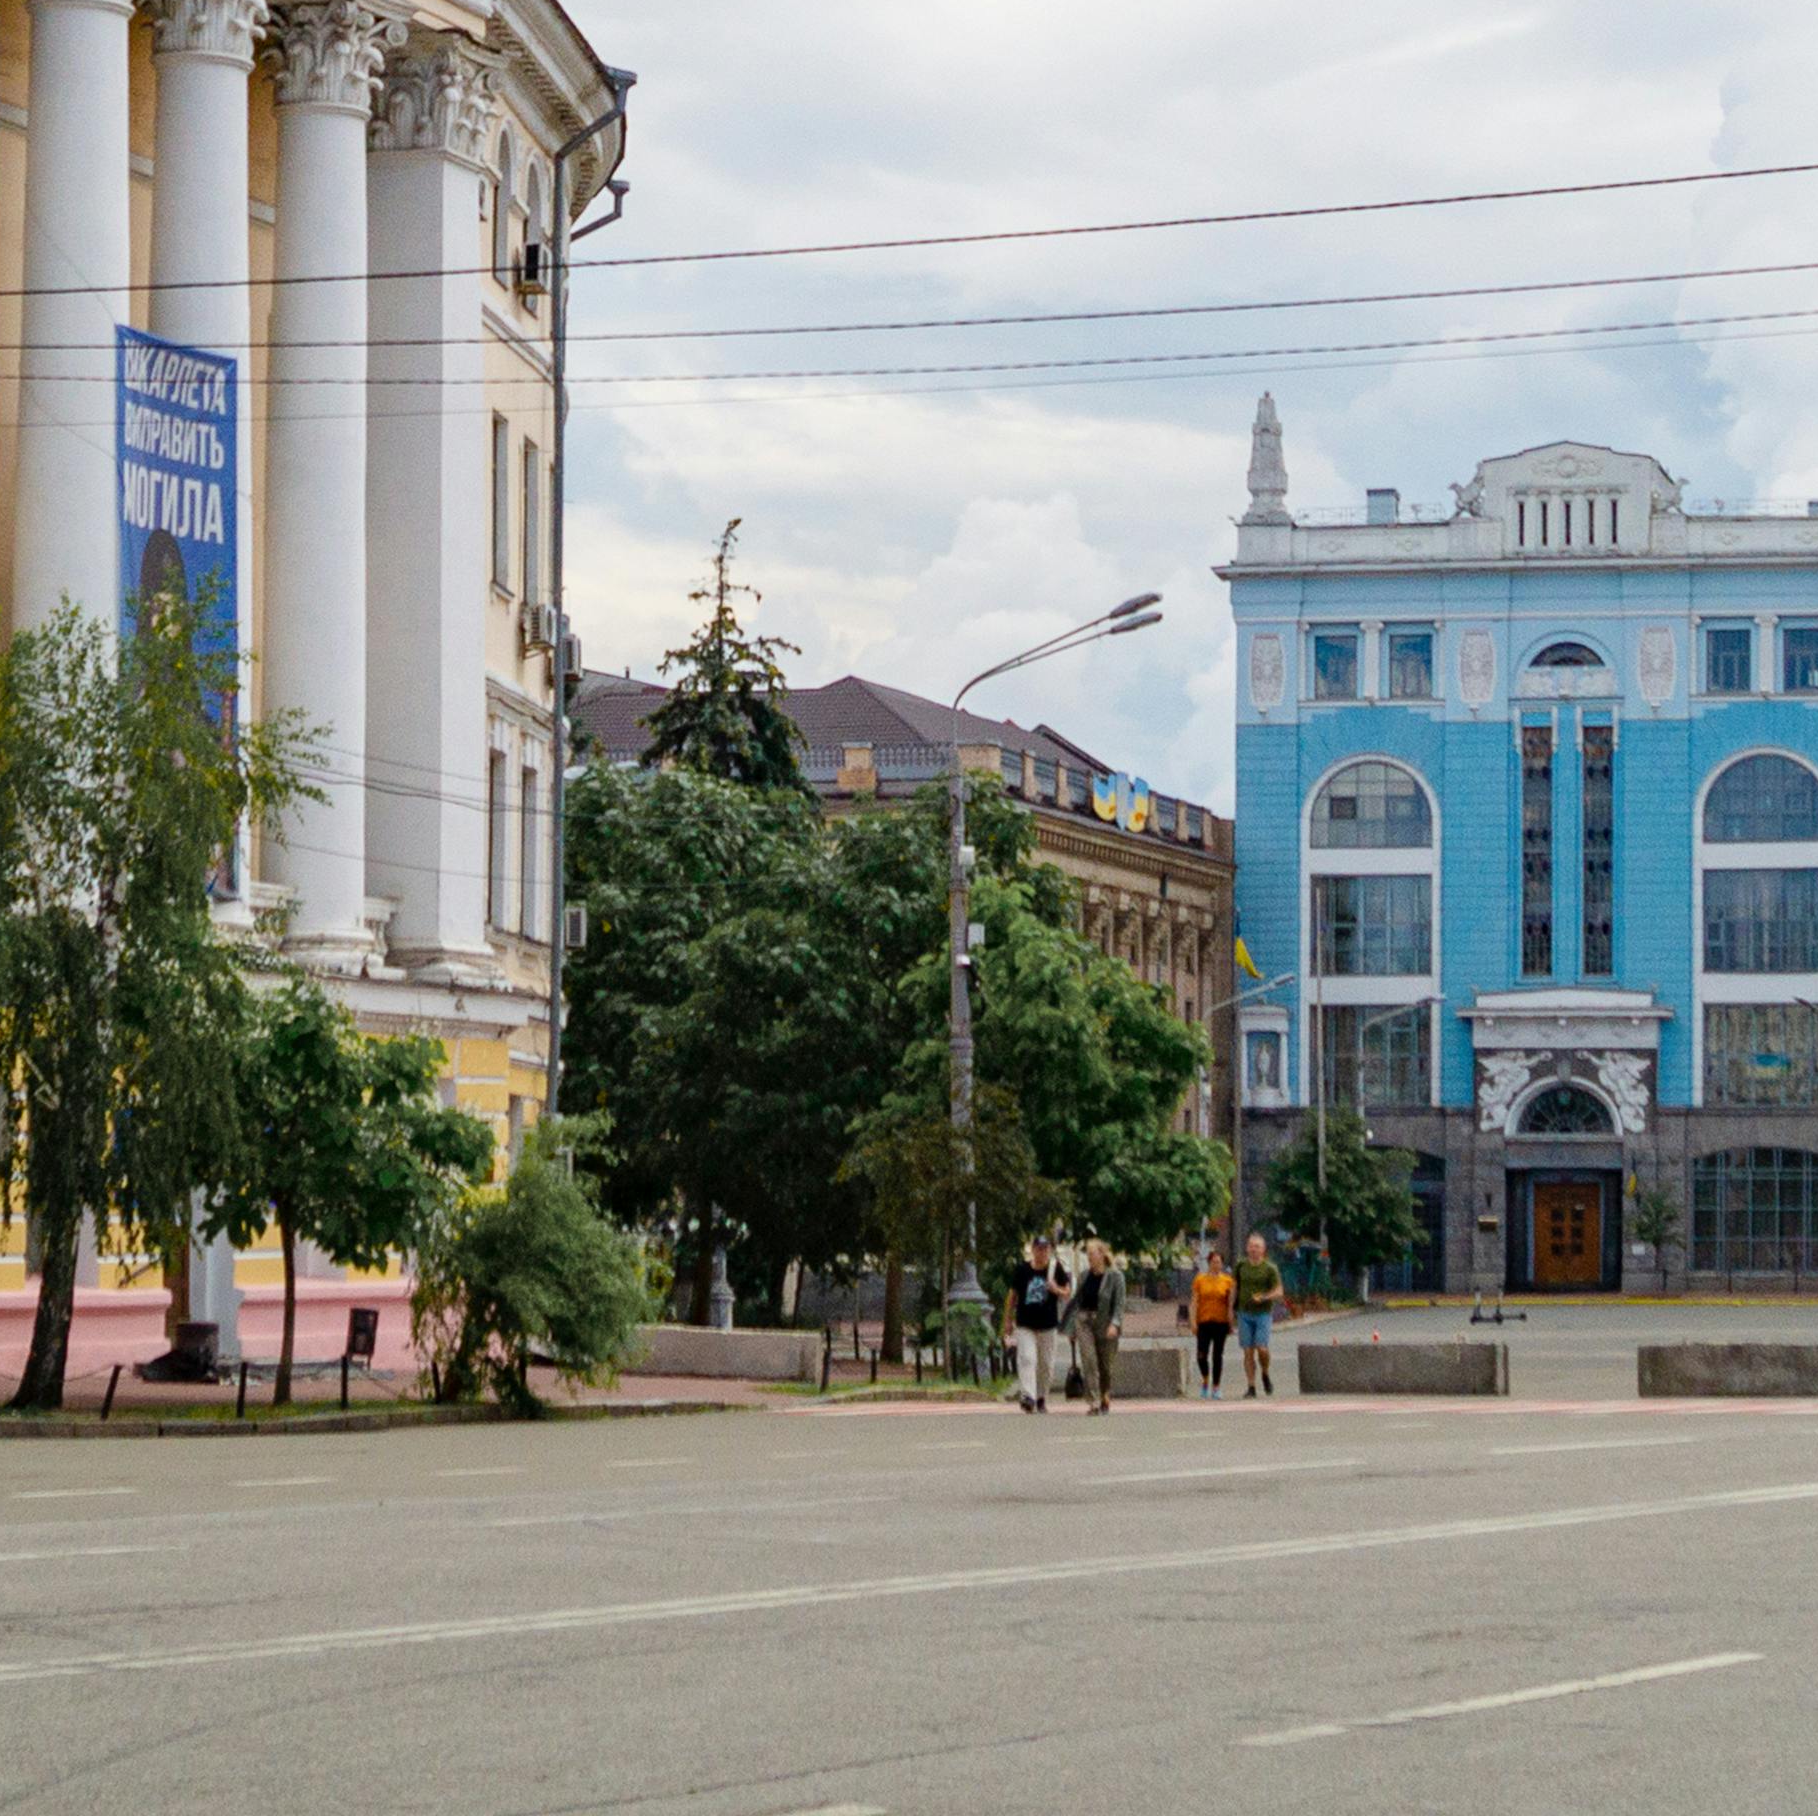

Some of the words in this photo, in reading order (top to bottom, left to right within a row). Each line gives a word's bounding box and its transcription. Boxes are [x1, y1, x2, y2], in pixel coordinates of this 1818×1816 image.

[124, 338, 226, 415] ШКАРЛЕТА
[124, 401, 225, 470] ВИПРАВИТЬ
[123, 460, 224, 545] МОГИЛА
